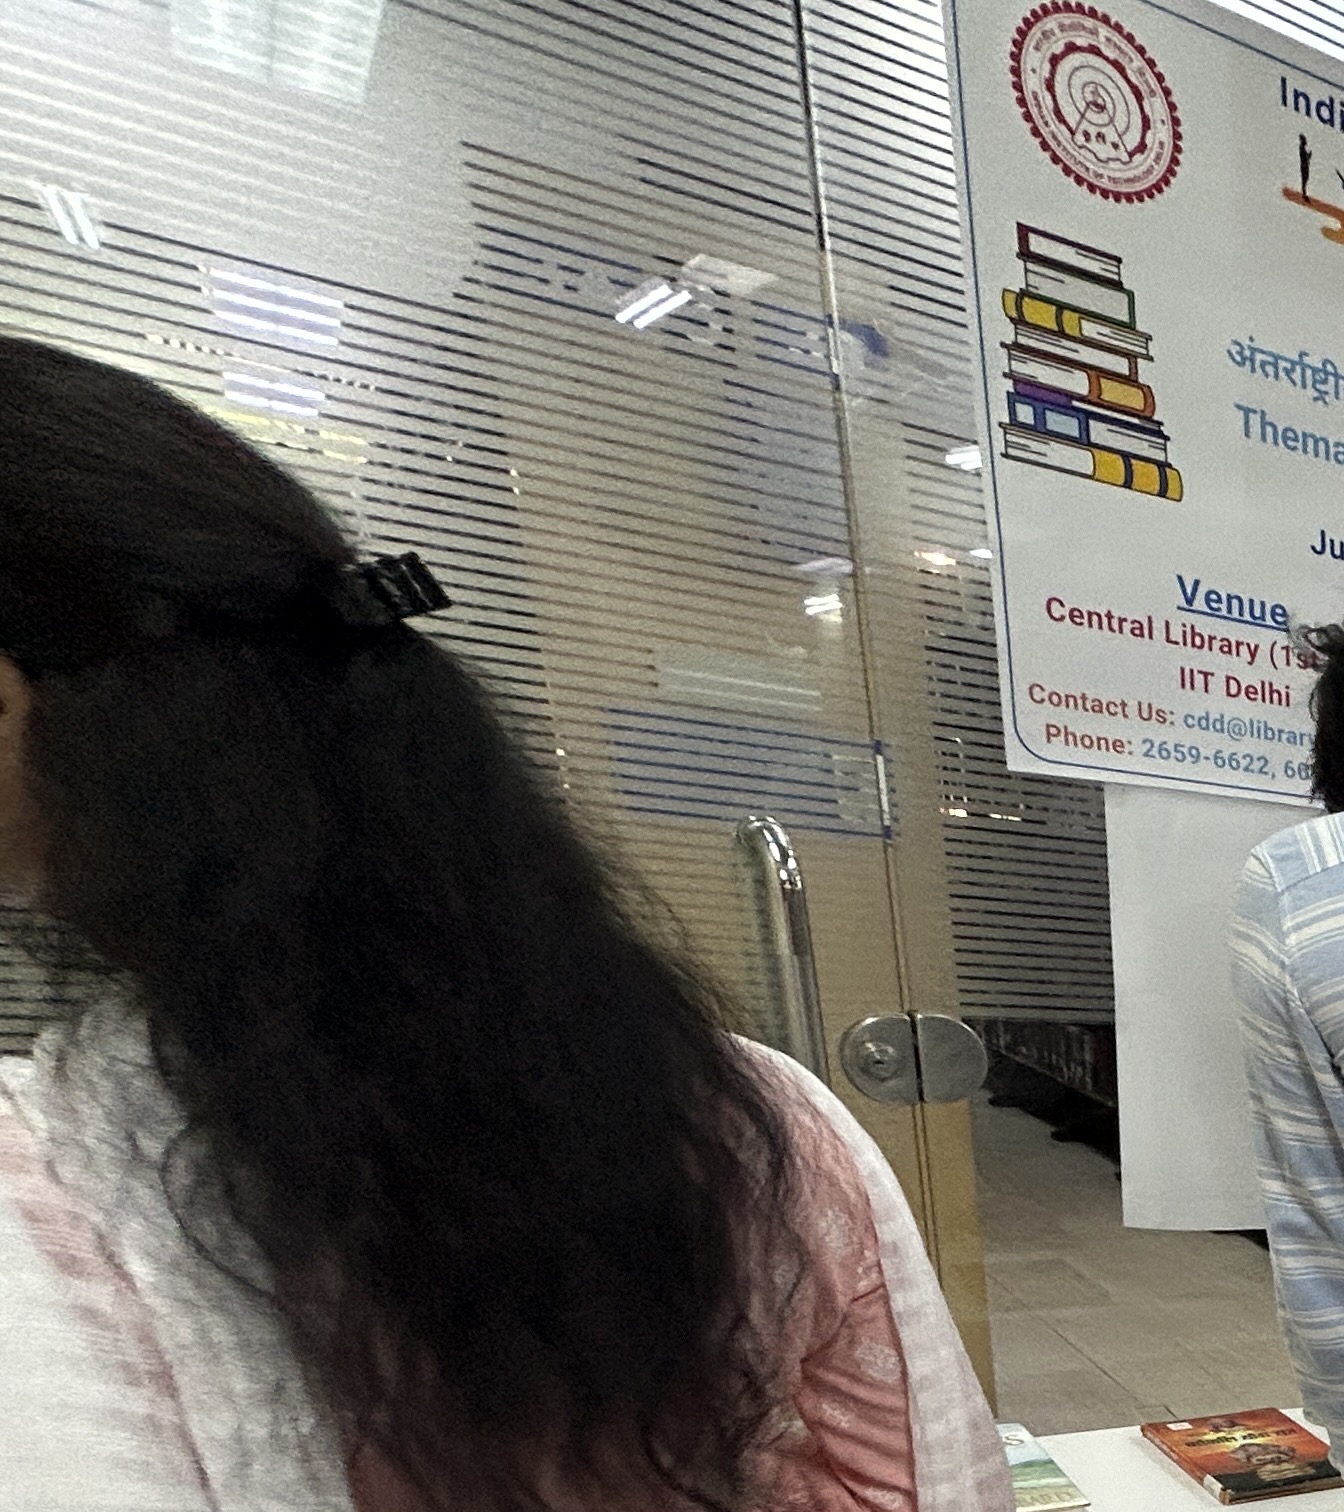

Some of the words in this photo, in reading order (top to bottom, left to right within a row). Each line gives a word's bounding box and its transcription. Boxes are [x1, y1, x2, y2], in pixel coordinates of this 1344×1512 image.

[1176, 574, 1290, 628] Venue
[1045, 597, 1154, 640] Central
[1165, 620, 1260, 666] Library
[1028, 683, 1129, 719] Contact
[1138, 701, 1175, 726] Us:
[1180, 667, 1215, 694] IIT
[1225, 675, 1291, 708] Delhi
[1045, 723, 1133, 756] Phone:
[1142, 738, 1276, 780] 2659-6622,
